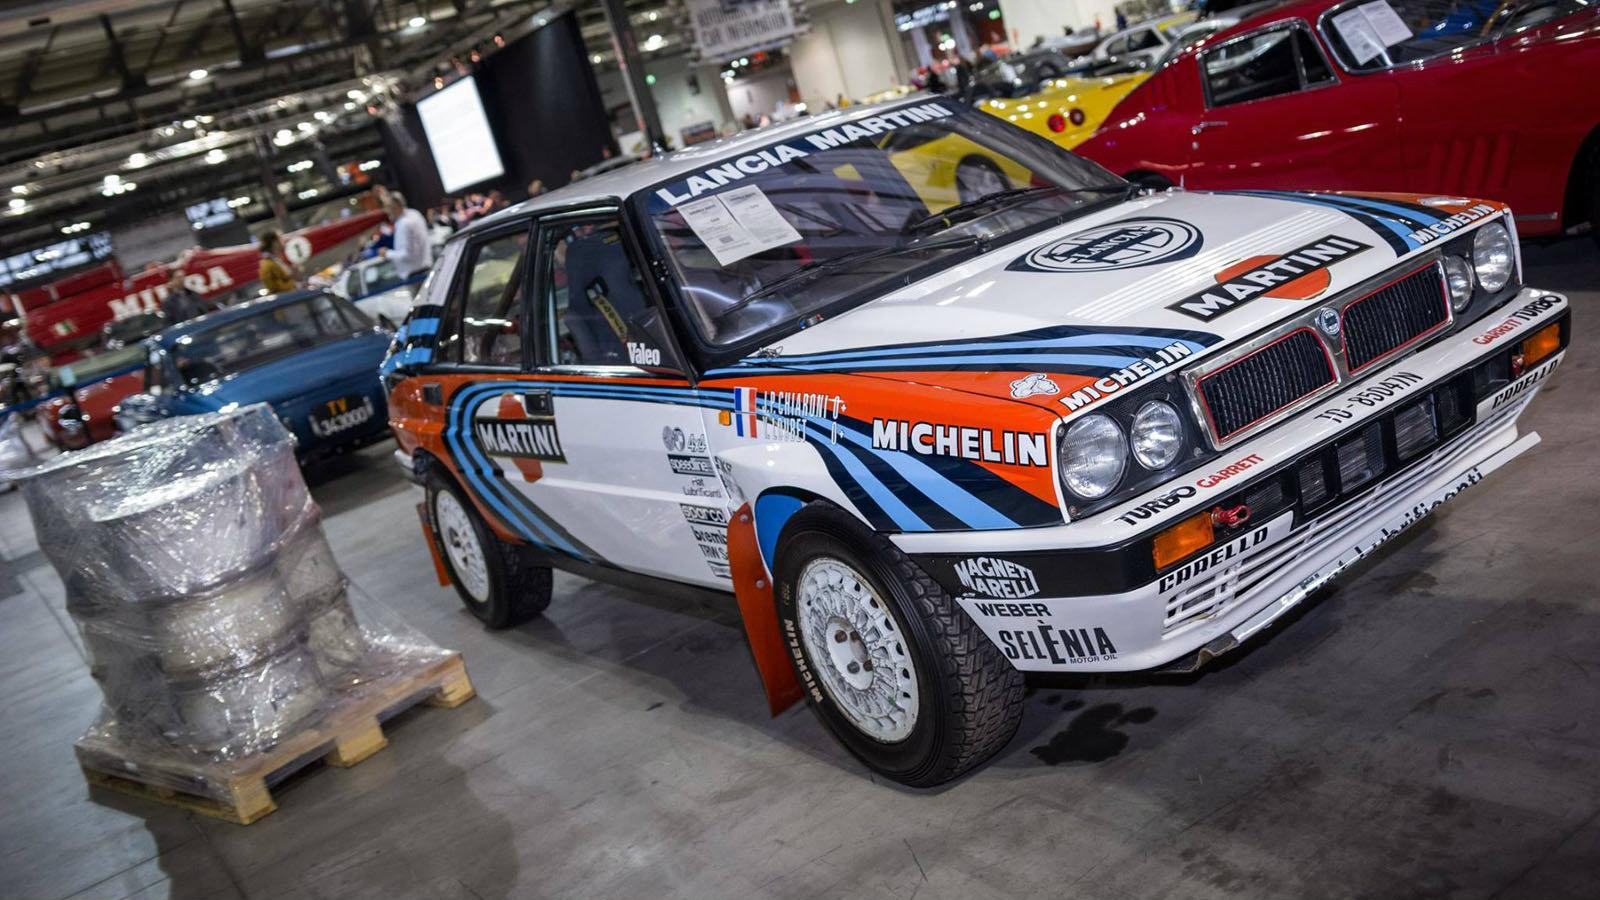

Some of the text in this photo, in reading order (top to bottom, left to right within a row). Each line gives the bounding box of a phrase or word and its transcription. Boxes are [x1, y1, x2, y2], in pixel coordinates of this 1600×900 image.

[656, 103, 953, 206] LANCIA MARTINI
[1407, 203, 1495, 245] MICHELIN
[108, 266, 235, 322] MIRA
[1180, 237, 1361, 316] MARTINI
[1472, 295, 1562, 346] GARRETT TURBO
[627, 342, 661, 366] Valeo
[1060, 342, 1194, 412] MICHELIN
[479, 423, 560, 456] MARTINI
[872, 418, 1049, 467] MICHELIN
[681, 505, 727, 523] sparco
[1113, 454, 1264, 526] TURBO GARRETT
[690, 525, 728, 545] bremb
[1159, 526, 1269, 595] CARELLO
[974, 603, 1052, 617] WEBER
[784, 618, 824, 704] MICHELIN
[1070, 654, 1118, 665] MOTOR OIL
